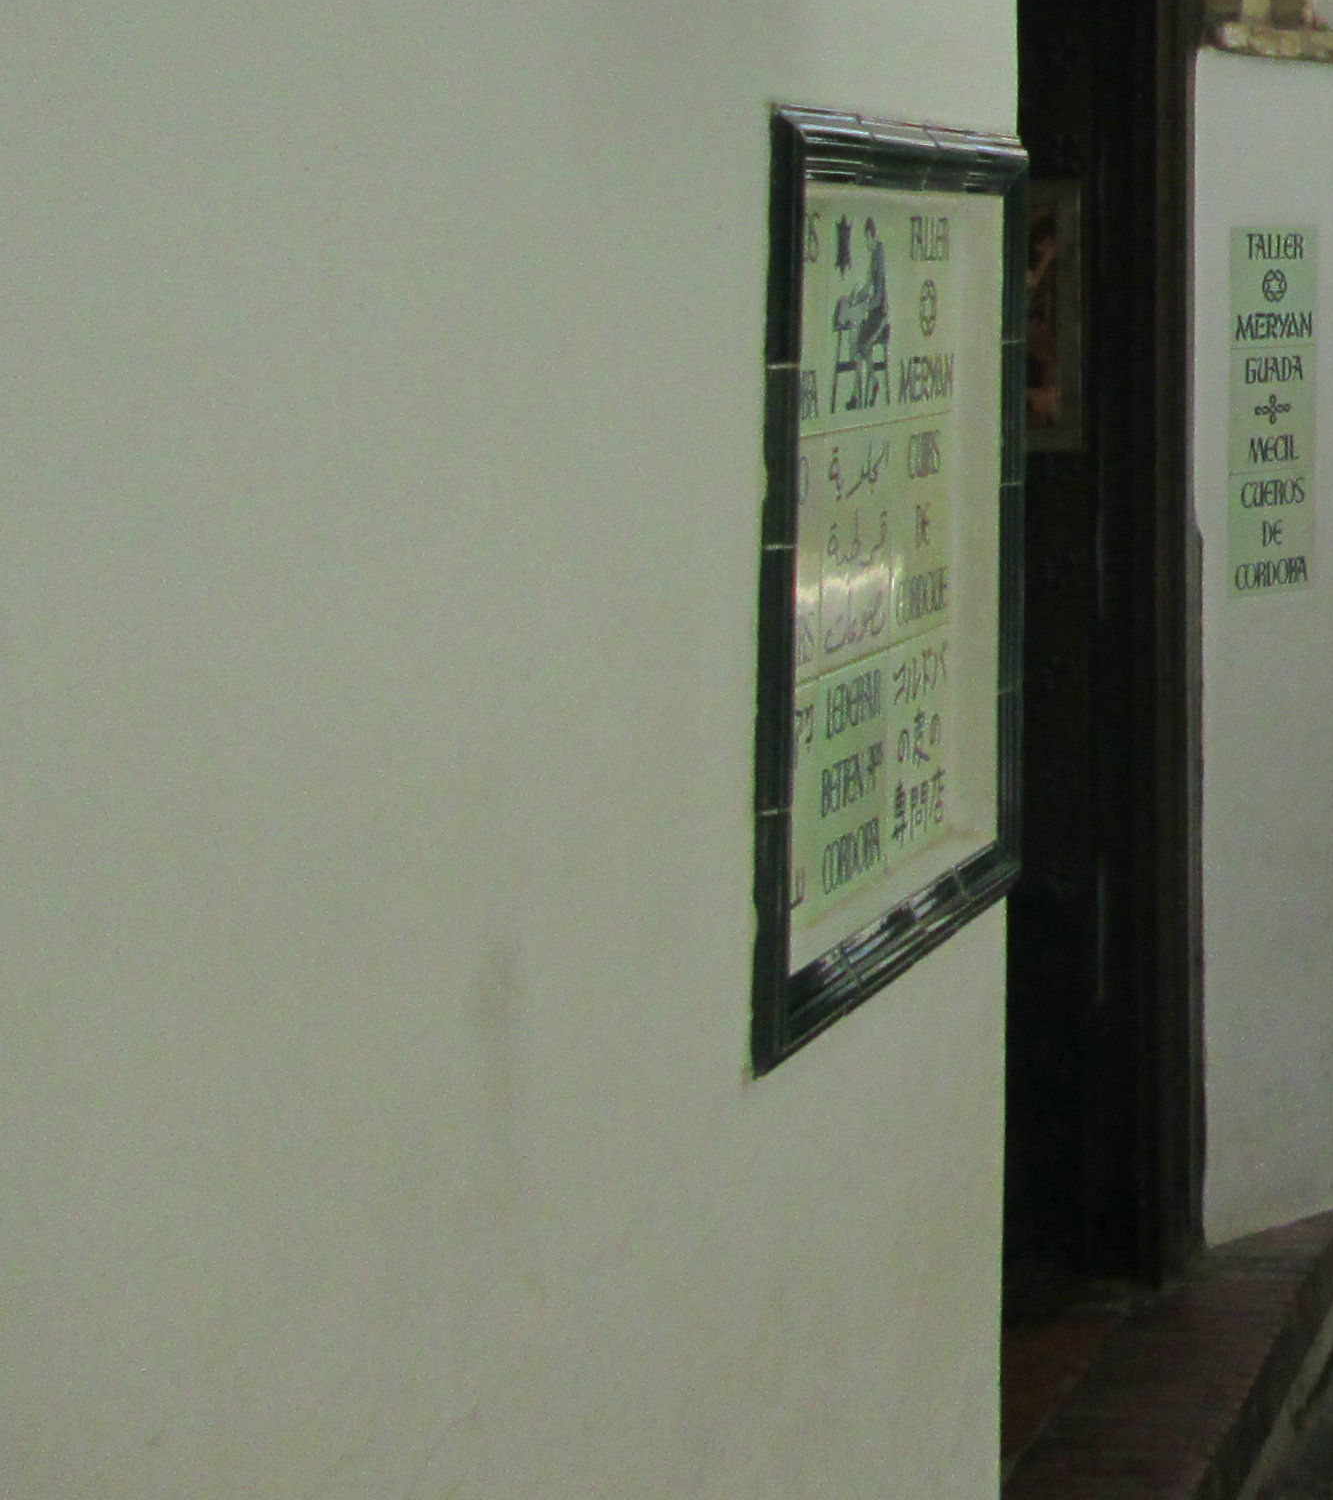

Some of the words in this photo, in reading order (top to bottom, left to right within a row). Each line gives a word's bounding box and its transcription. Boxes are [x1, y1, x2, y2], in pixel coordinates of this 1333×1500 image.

[909, 215, 950, 261] TALLER
[1246, 232, 1305, 260] TALLER
[1235, 311, 1313, 341] MERYAN
[898, 352, 954, 405] MERYAN
[1245, 355, 1304, 385] GUADA
[1249, 433, 1300, 464] MECIL
[1241, 477, 1306, 509] CUEROS
[914, 500, 932, 550] DE
[1262, 519, 1284, 547] DE
[1234, 555, 1309, 591] CORDOBA
[821, 816, 882, 896] CORDOBA
